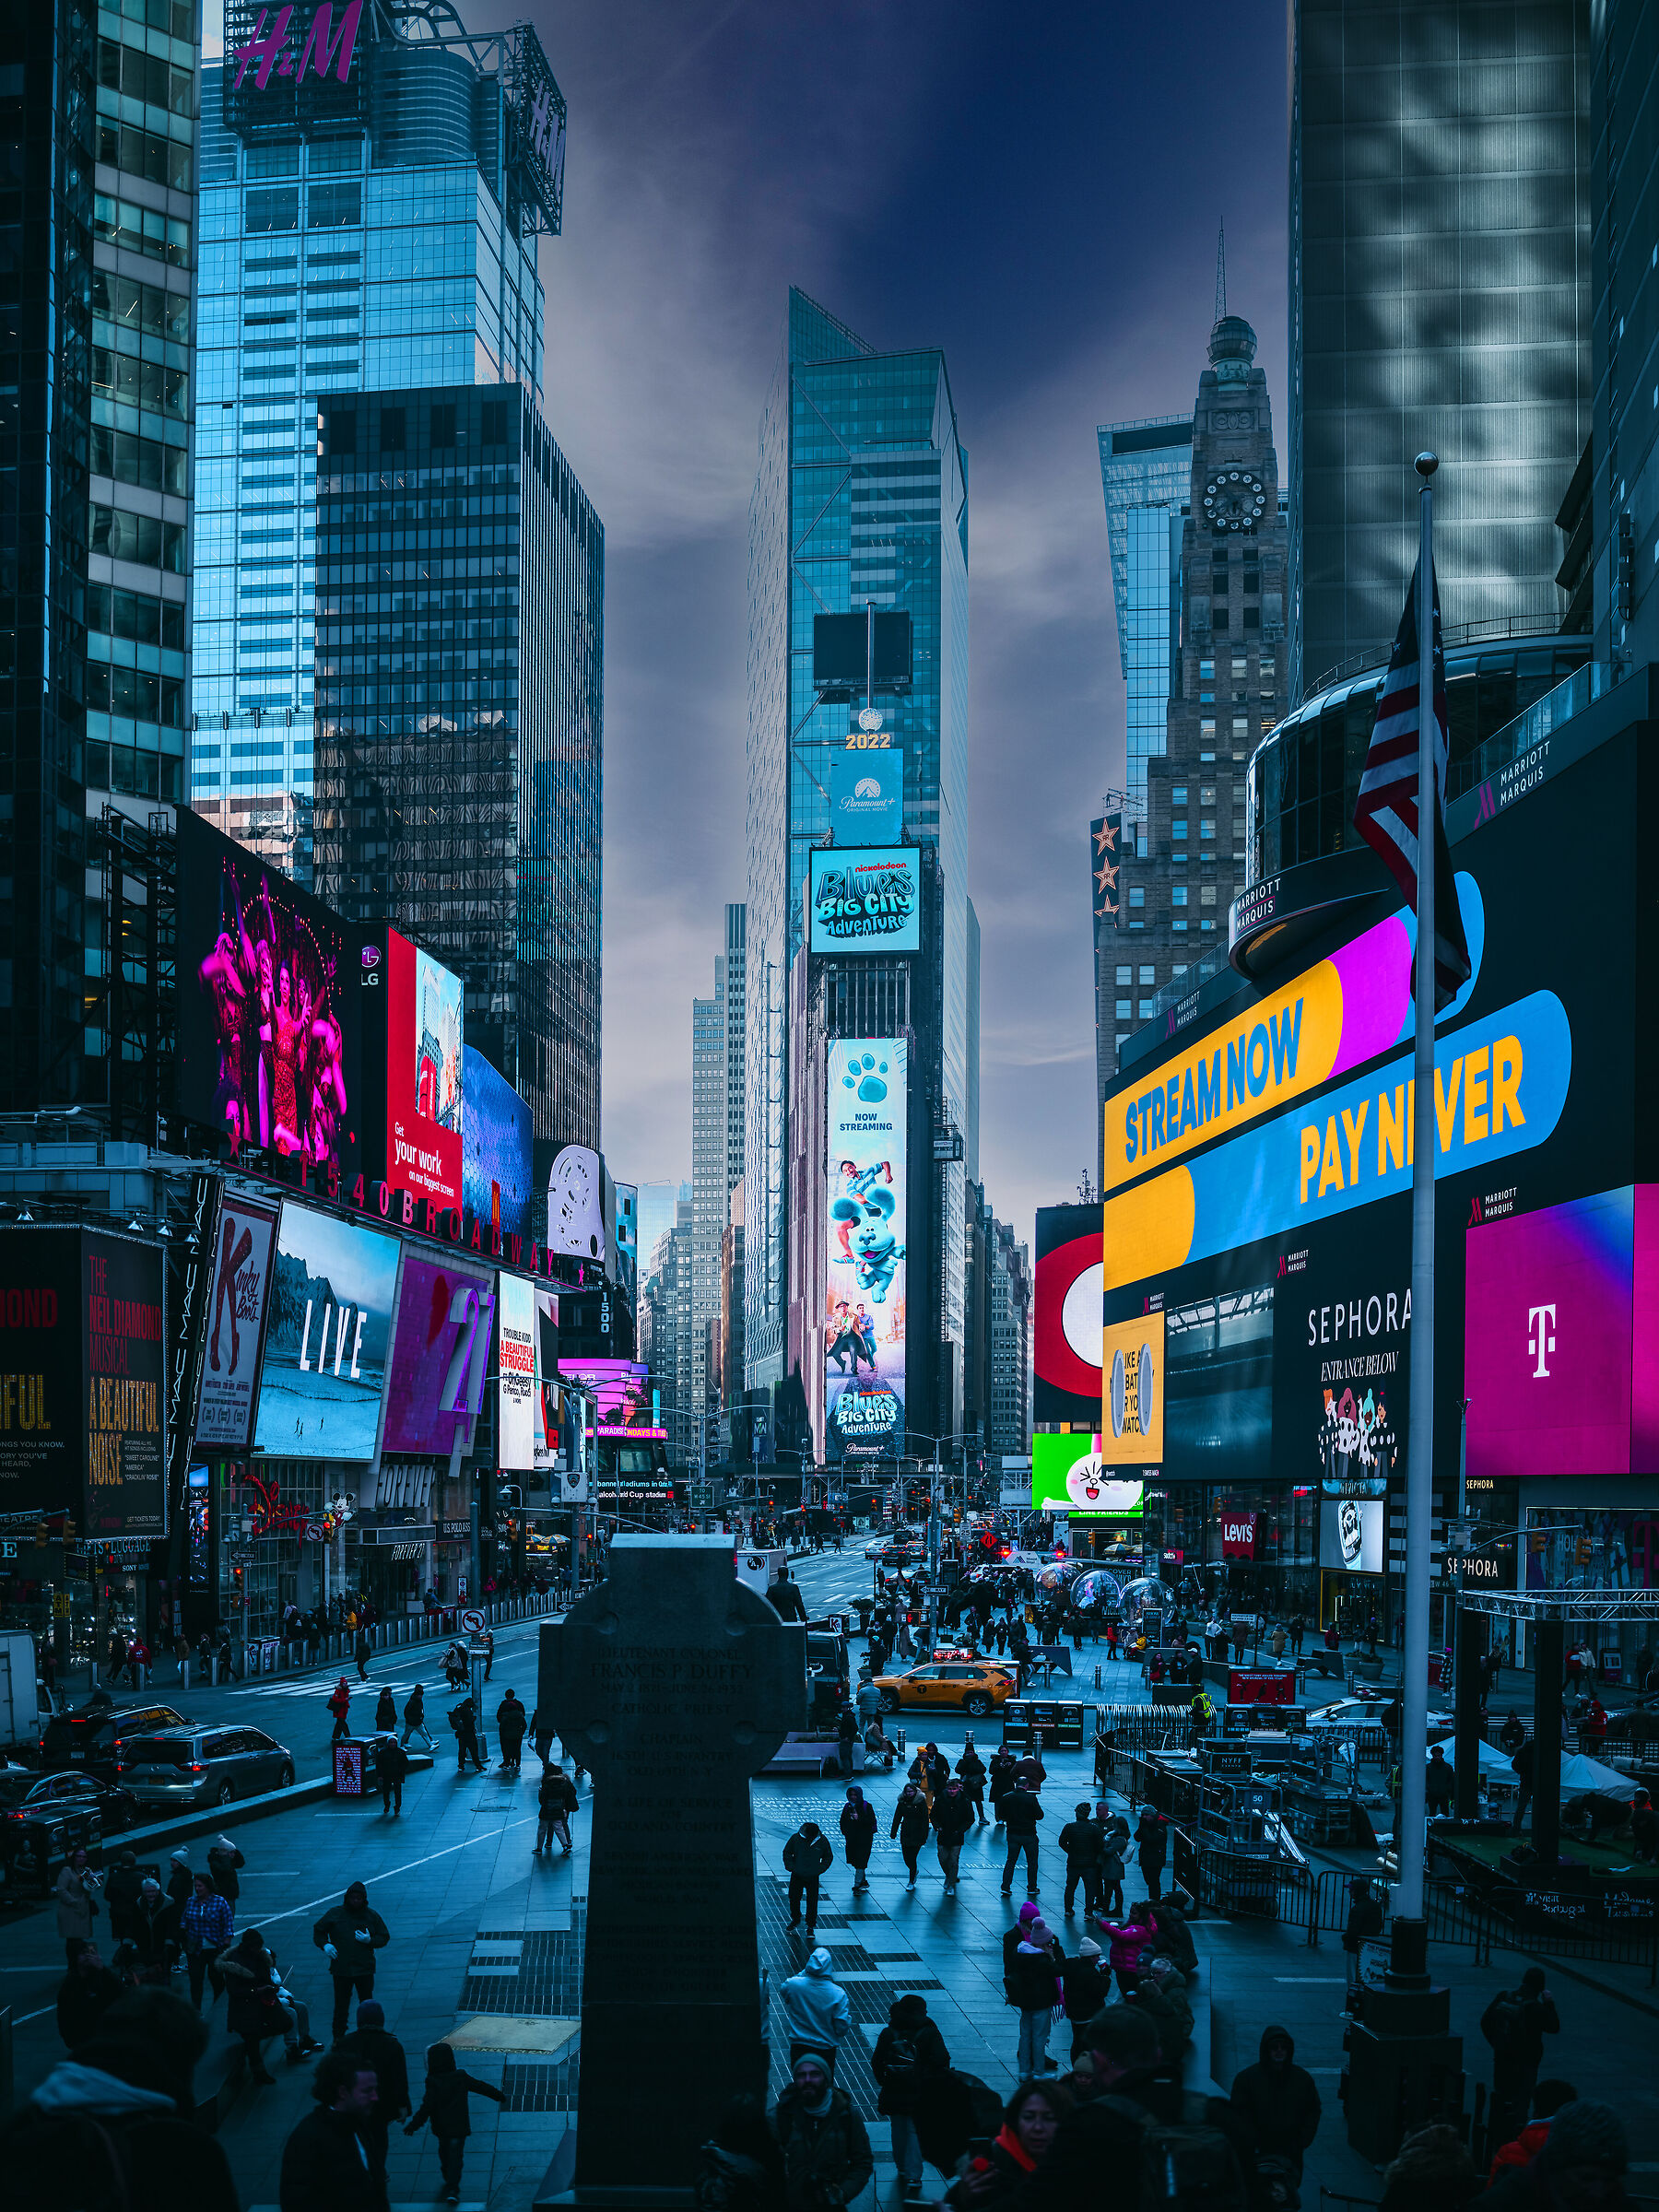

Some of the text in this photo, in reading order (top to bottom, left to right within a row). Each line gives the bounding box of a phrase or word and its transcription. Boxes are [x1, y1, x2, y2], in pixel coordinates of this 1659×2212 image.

[233, 0, 363, 90] H&M
[845, 734, 891, 750] 2022
[1500, 740, 1550, 786] MARRIOTT
[1500, 766, 1544, 806] MARQUIS
[839, 796, 896, 810] Paramount+
[855, 862, 907, 873] nickelodeon
[818, 866, 915, 901] Blue's
[1236, 878, 1281, 915] MARRIOTT
[818, 899, 862, 921] BIG
[1236, 900, 1274, 933] MARQUIS
[360, 972, 379, 986] LG
[1177, 991, 1200, 1015] MARRIOTT
[1177, 1006, 1198, 1028] MARQUIS
[1125, 998, 1304, 1164] STREAM NOW
[840, 1123, 893, 1132] STREAMING
[854, 1112, 877, 1122] NOW
[1300, 1034, 1527, 1204] PAY NVER
[394, 1122, 405, 1137] Get
[394, 1138, 442, 1177] your work
[409, 1171, 454, 1198] on our biggest screen
[1485, 1187, 1517, 1205] MARRIOTT
[1485, 1201, 1513, 1218] MARQUIS
[402, 1190, 555, 1276] BROADWAY
[1288, 1249, 1310, 1262] MARRIOTT
[1288, 1260, 1307, 1273] MARQUIS
[88, 1255, 108, 1295] THE
[88, 1294, 161, 1342] NEIL DIAMOND
[600, 1291, 610, 1334] 1500
[1308, 1288, 1412, 1347] SEPHORA
[300, 1299, 368, 1379] LIVE
[503, 1327, 532, 1344] TROUBLE KIDD
[88, 1334, 130, 1374] MUSICAL
[500, 1340, 535, 1359] A BEAUTIFUL
[1124, 1352, 1135, 1369] IKE
[500, 1352, 535, 1373] STRUGGLE
[1320, 1351, 1400, 1382] ENTRANCE BELOW
[0, 1372, 52, 1430] FUL
[89, 1376, 159, 1433] A BEAUTIFUL
[835, 1392, 898, 1416] Blue's
[837, 1408, 897, 1425] BIG CITY
[1122, 1417, 1141, 1434] WATC
[1, 1460, 31, 1468] HEARD,
[88, 1432, 124, 1486] NOISE
[1465, 1479, 1494, 1489] SEPHORA
[0, 1515, 40, 1524] EATRE
[451, 1523, 463, 1533] POLO
[462, 1522, 471, 1532] ASS
[111, 1540, 151, 1554] LUGGAGE
[392, 1544, 417, 1561] FOREVER
[122, 1564, 137, 1572] SONY
